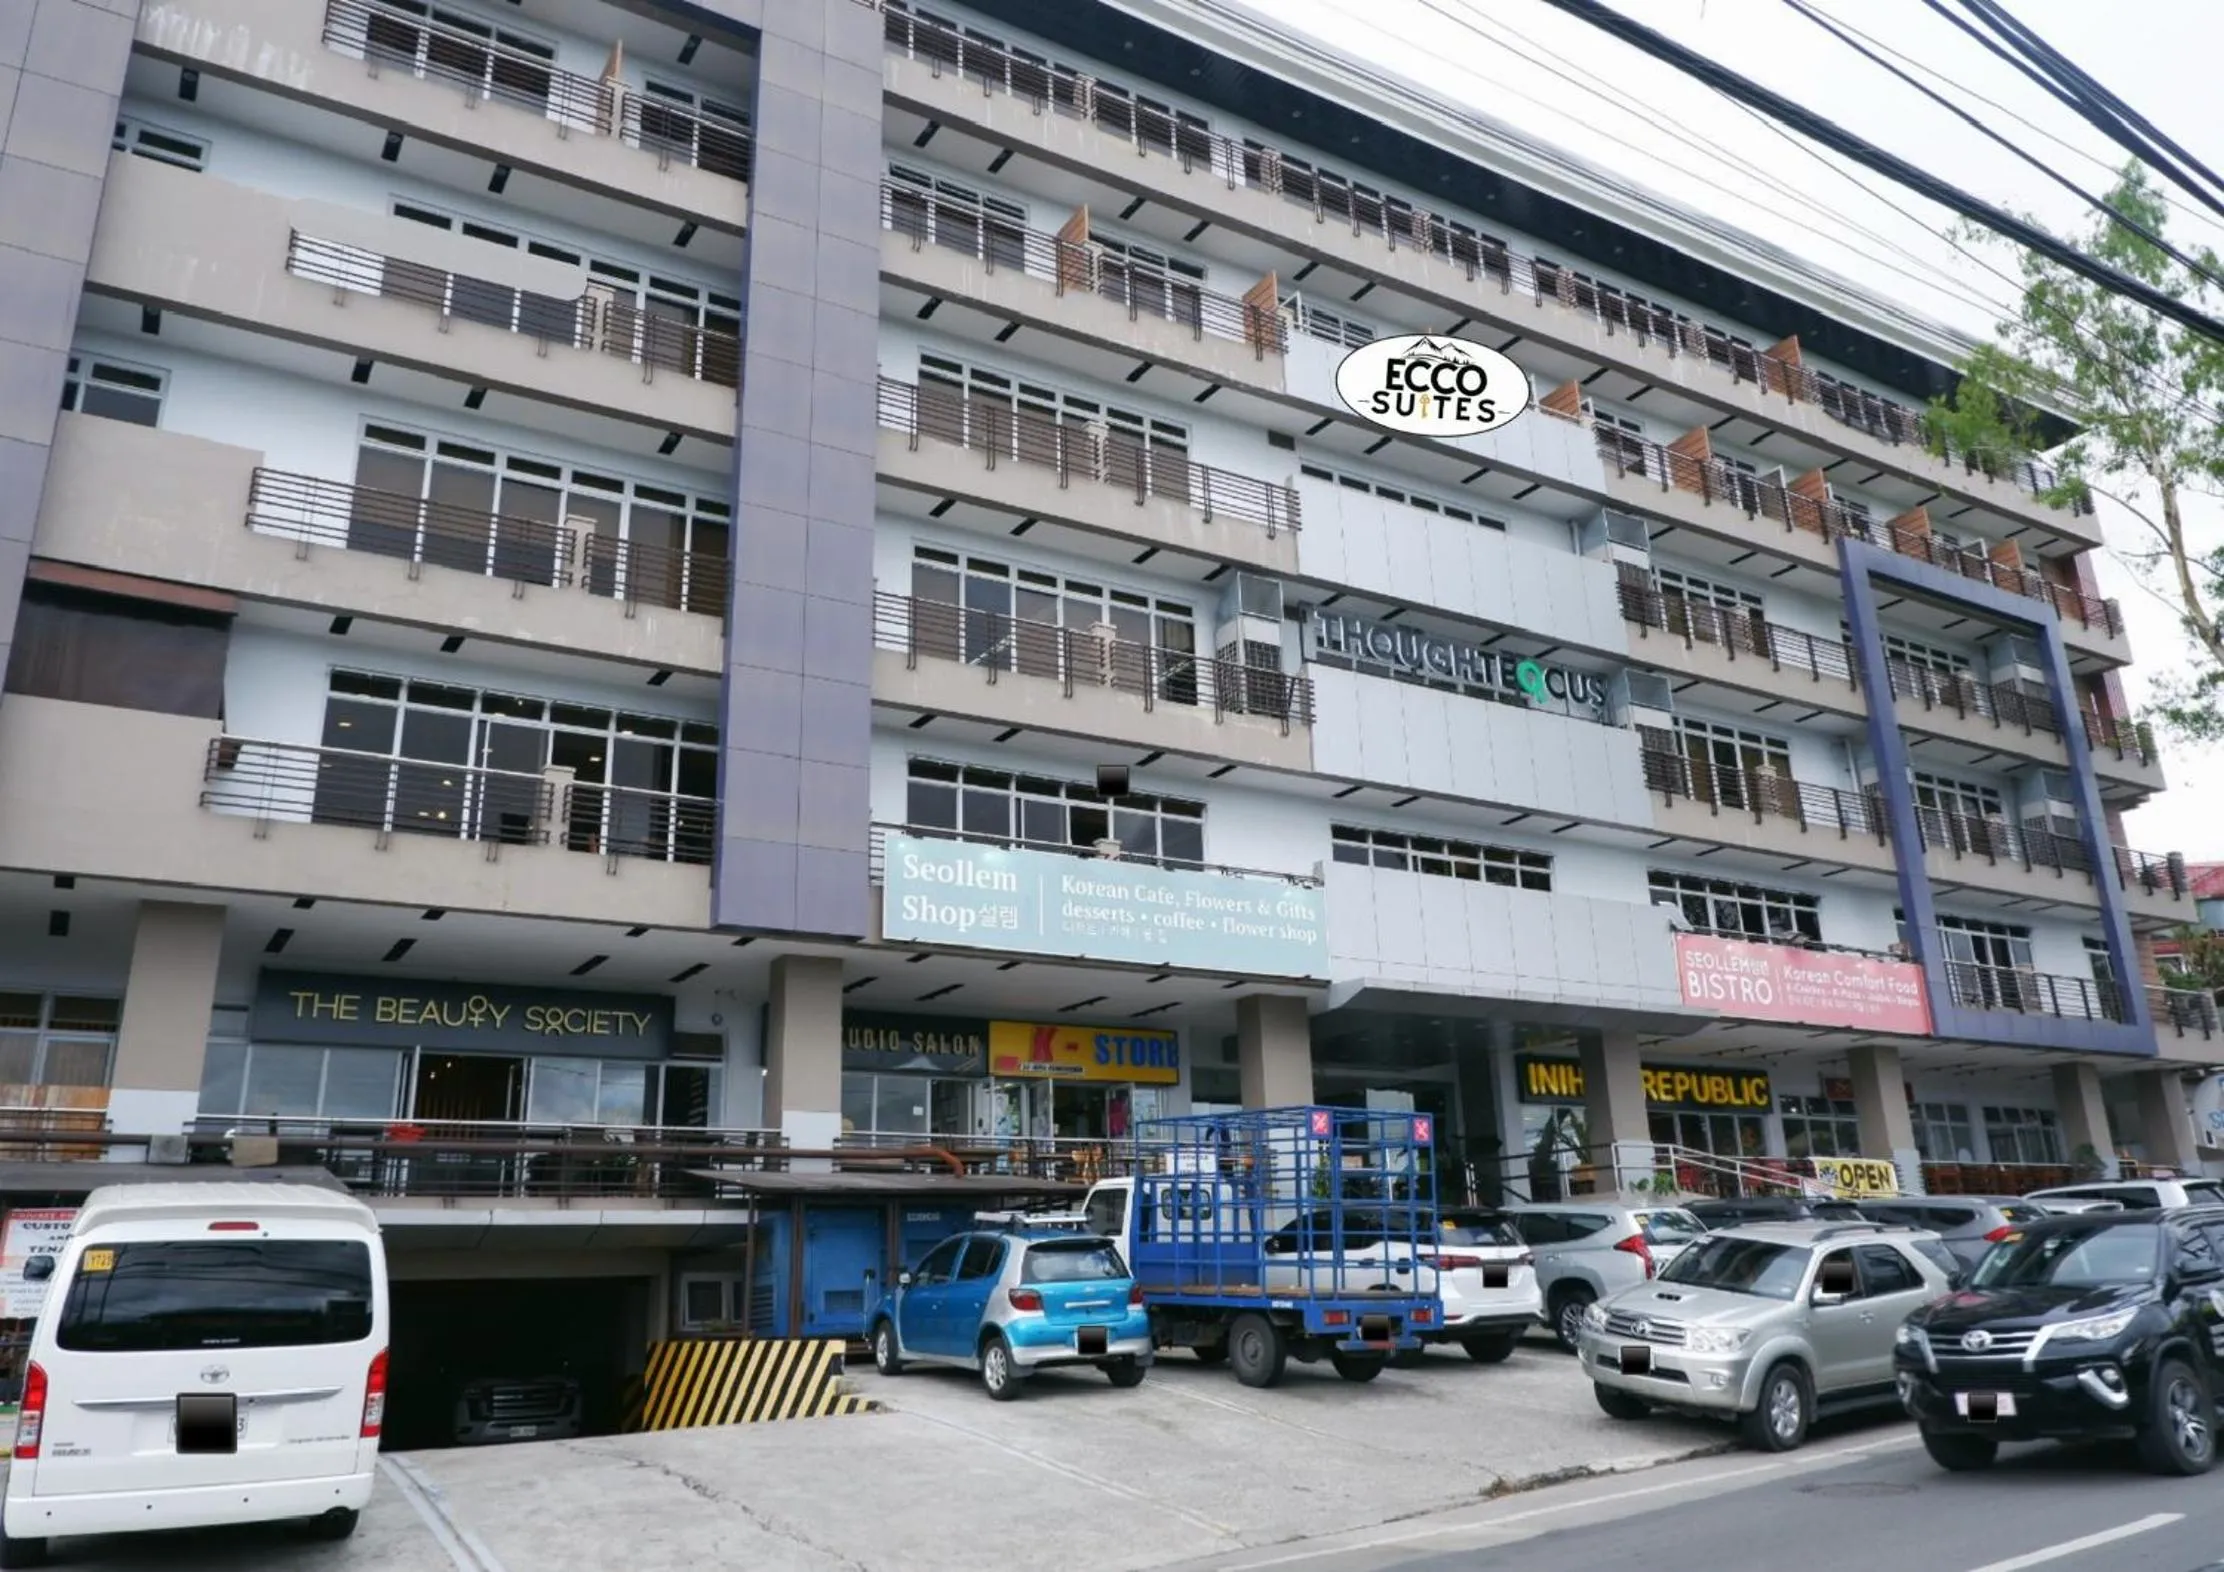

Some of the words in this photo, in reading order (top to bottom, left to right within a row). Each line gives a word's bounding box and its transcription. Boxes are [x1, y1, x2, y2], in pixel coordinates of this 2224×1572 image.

[1386, 358, 1488, 397] ECCO
[1371, 390, 1496, 423] SUITES
[903, 854, 1018, 893] Seollem
[902, 894, 976, 932] Shop
[978, 903, 1019, 930] 설렘
[1062, 875, 1130, 901] Korean
[1185, 890, 1252, 916] Flowers
[1257, 902, 1272, 917] &
[1276, 901, 1317, 923] Gifts
[1062, 901, 1135, 923] desserts
[1153, 910, 1206, 931] coffee
[1222, 917, 1275, 940] flower
[1279, 924, 1318, 945] shop
[1685, 950, 1751, 973] SEOLLEM
[1687, 970, 1773, 1005] BISTRO
[1783, 965, 1831, 984] Korean
[1834, 970, 1885, 990] Comfort
[1887, 976, 1919, 995] Food
[289, 991, 361, 1021] THE
[524, 1004, 652, 1037] SOCIETY
[843, 1027, 900, 1051] UDIO
[912, 1031, 981, 1056] SALON
[1528, 1062, 1585, 1097] INIH
[1640, 1069, 1769, 1107] REPUBLIC
[1840, 1163, 1892, 1190] OPEN
[23, 1222, 72, 1230] CUSTO
